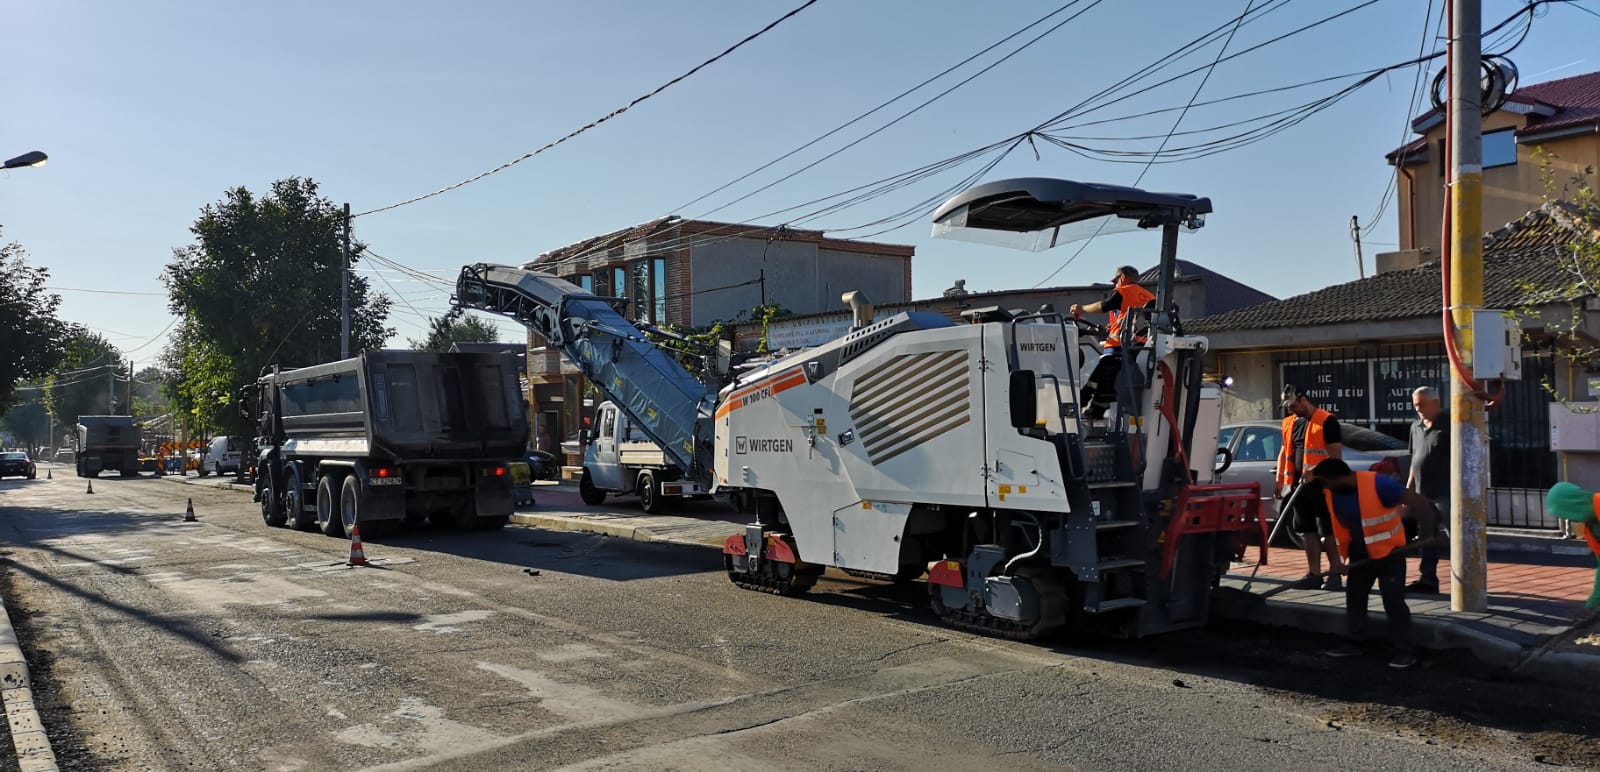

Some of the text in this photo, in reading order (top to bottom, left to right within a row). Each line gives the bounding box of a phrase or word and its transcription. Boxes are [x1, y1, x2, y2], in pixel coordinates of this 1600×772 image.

[1020, 343, 1056, 352] WIRTGEN
[749, 391, 760, 404] 100
[749, 439, 793, 452] WIRTGEN
